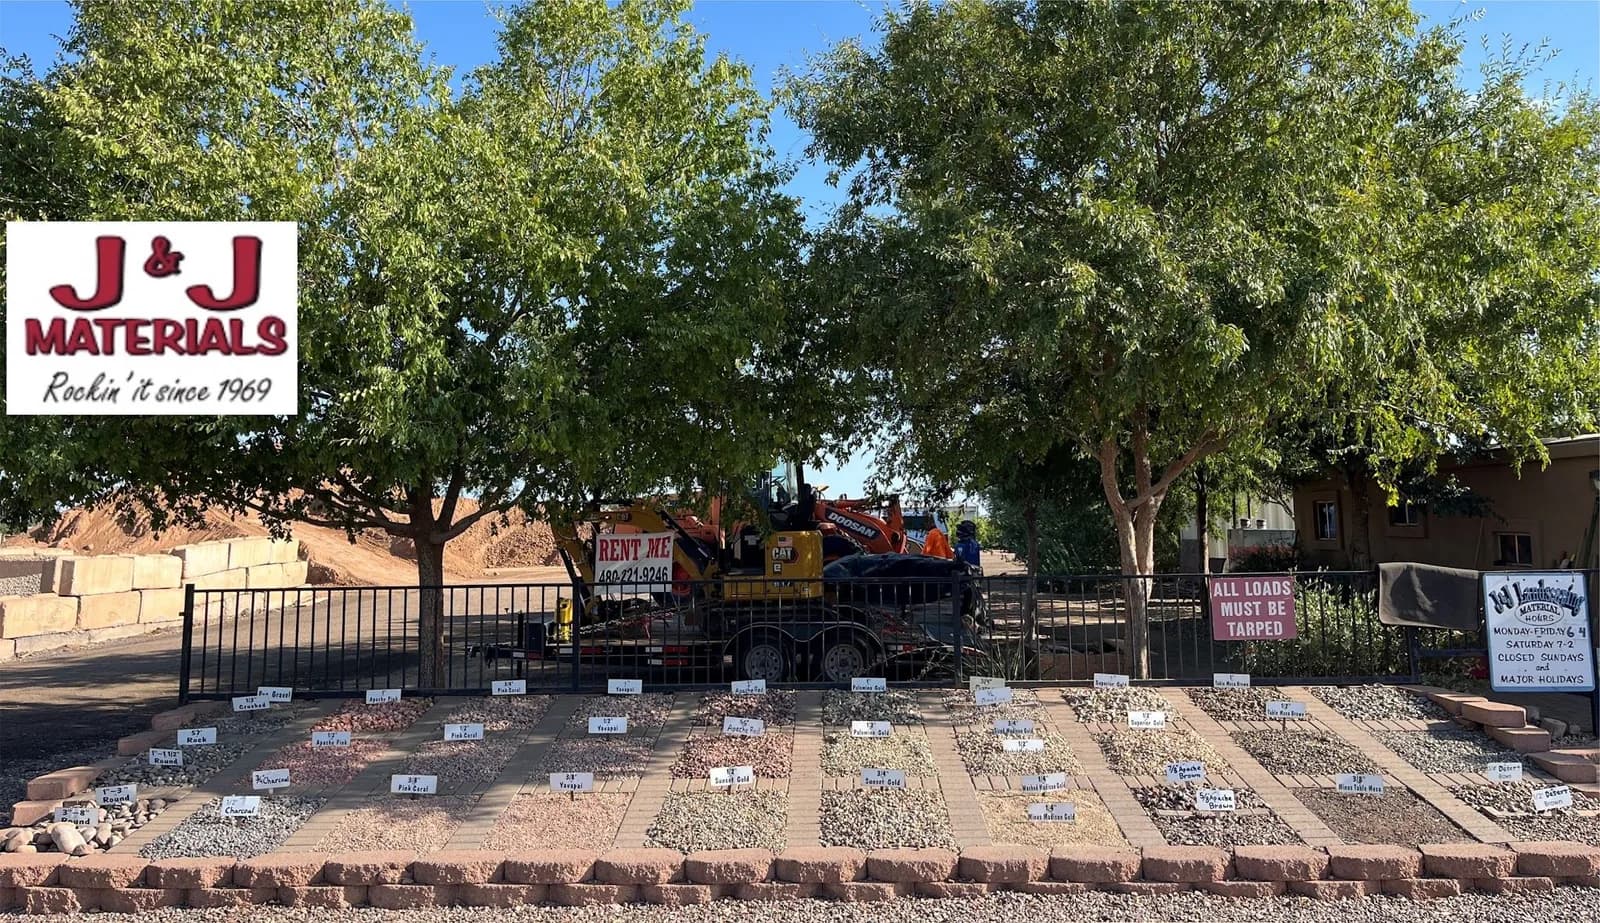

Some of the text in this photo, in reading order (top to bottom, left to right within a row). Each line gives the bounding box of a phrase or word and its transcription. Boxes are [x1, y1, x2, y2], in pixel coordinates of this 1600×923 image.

[827, 511, 877, 538] DOOSAN
[599, 536, 671, 561] RENT ME
[772, 547, 793, 560] CAT
[1213, 580, 1291, 597] ALL LOADS
[1220, 601, 1287, 617] MUST BE
[1520, 603, 1560, 616] MATERIAL
[1226, 621, 1283, 637] TARPED
[1506, 640, 1574, 649] SATURDAY 7-2
[1498, 653, 1584, 662] CLOSED SUNDAYS
[1535, 663, 1550, 671] and
[1501, 675, 1584, 684] MAJOR HOLIDAYS
[224, 805, 255, 814] Charcoal
